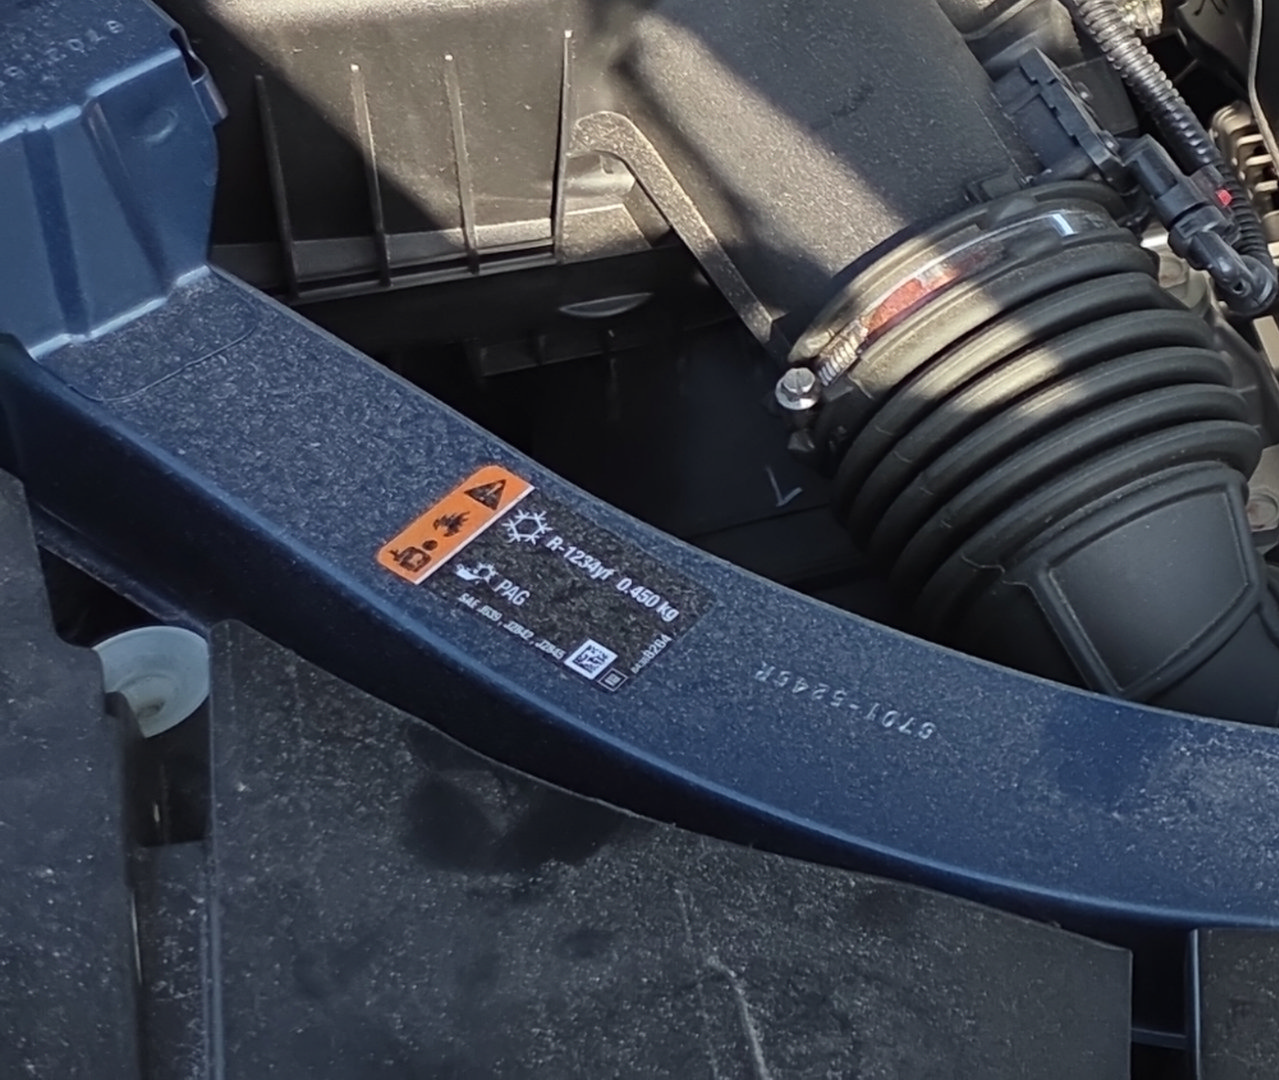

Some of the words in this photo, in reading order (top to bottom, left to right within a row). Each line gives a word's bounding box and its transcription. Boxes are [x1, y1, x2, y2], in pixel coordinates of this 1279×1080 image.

[493, 578, 531, 606] PAG
[545, 535, 615, 581] R-1234yf
[616, 577, 661, 608] 0.450
[655, 600, 680, 622] kg
[457, 592, 480, 609] SAE
